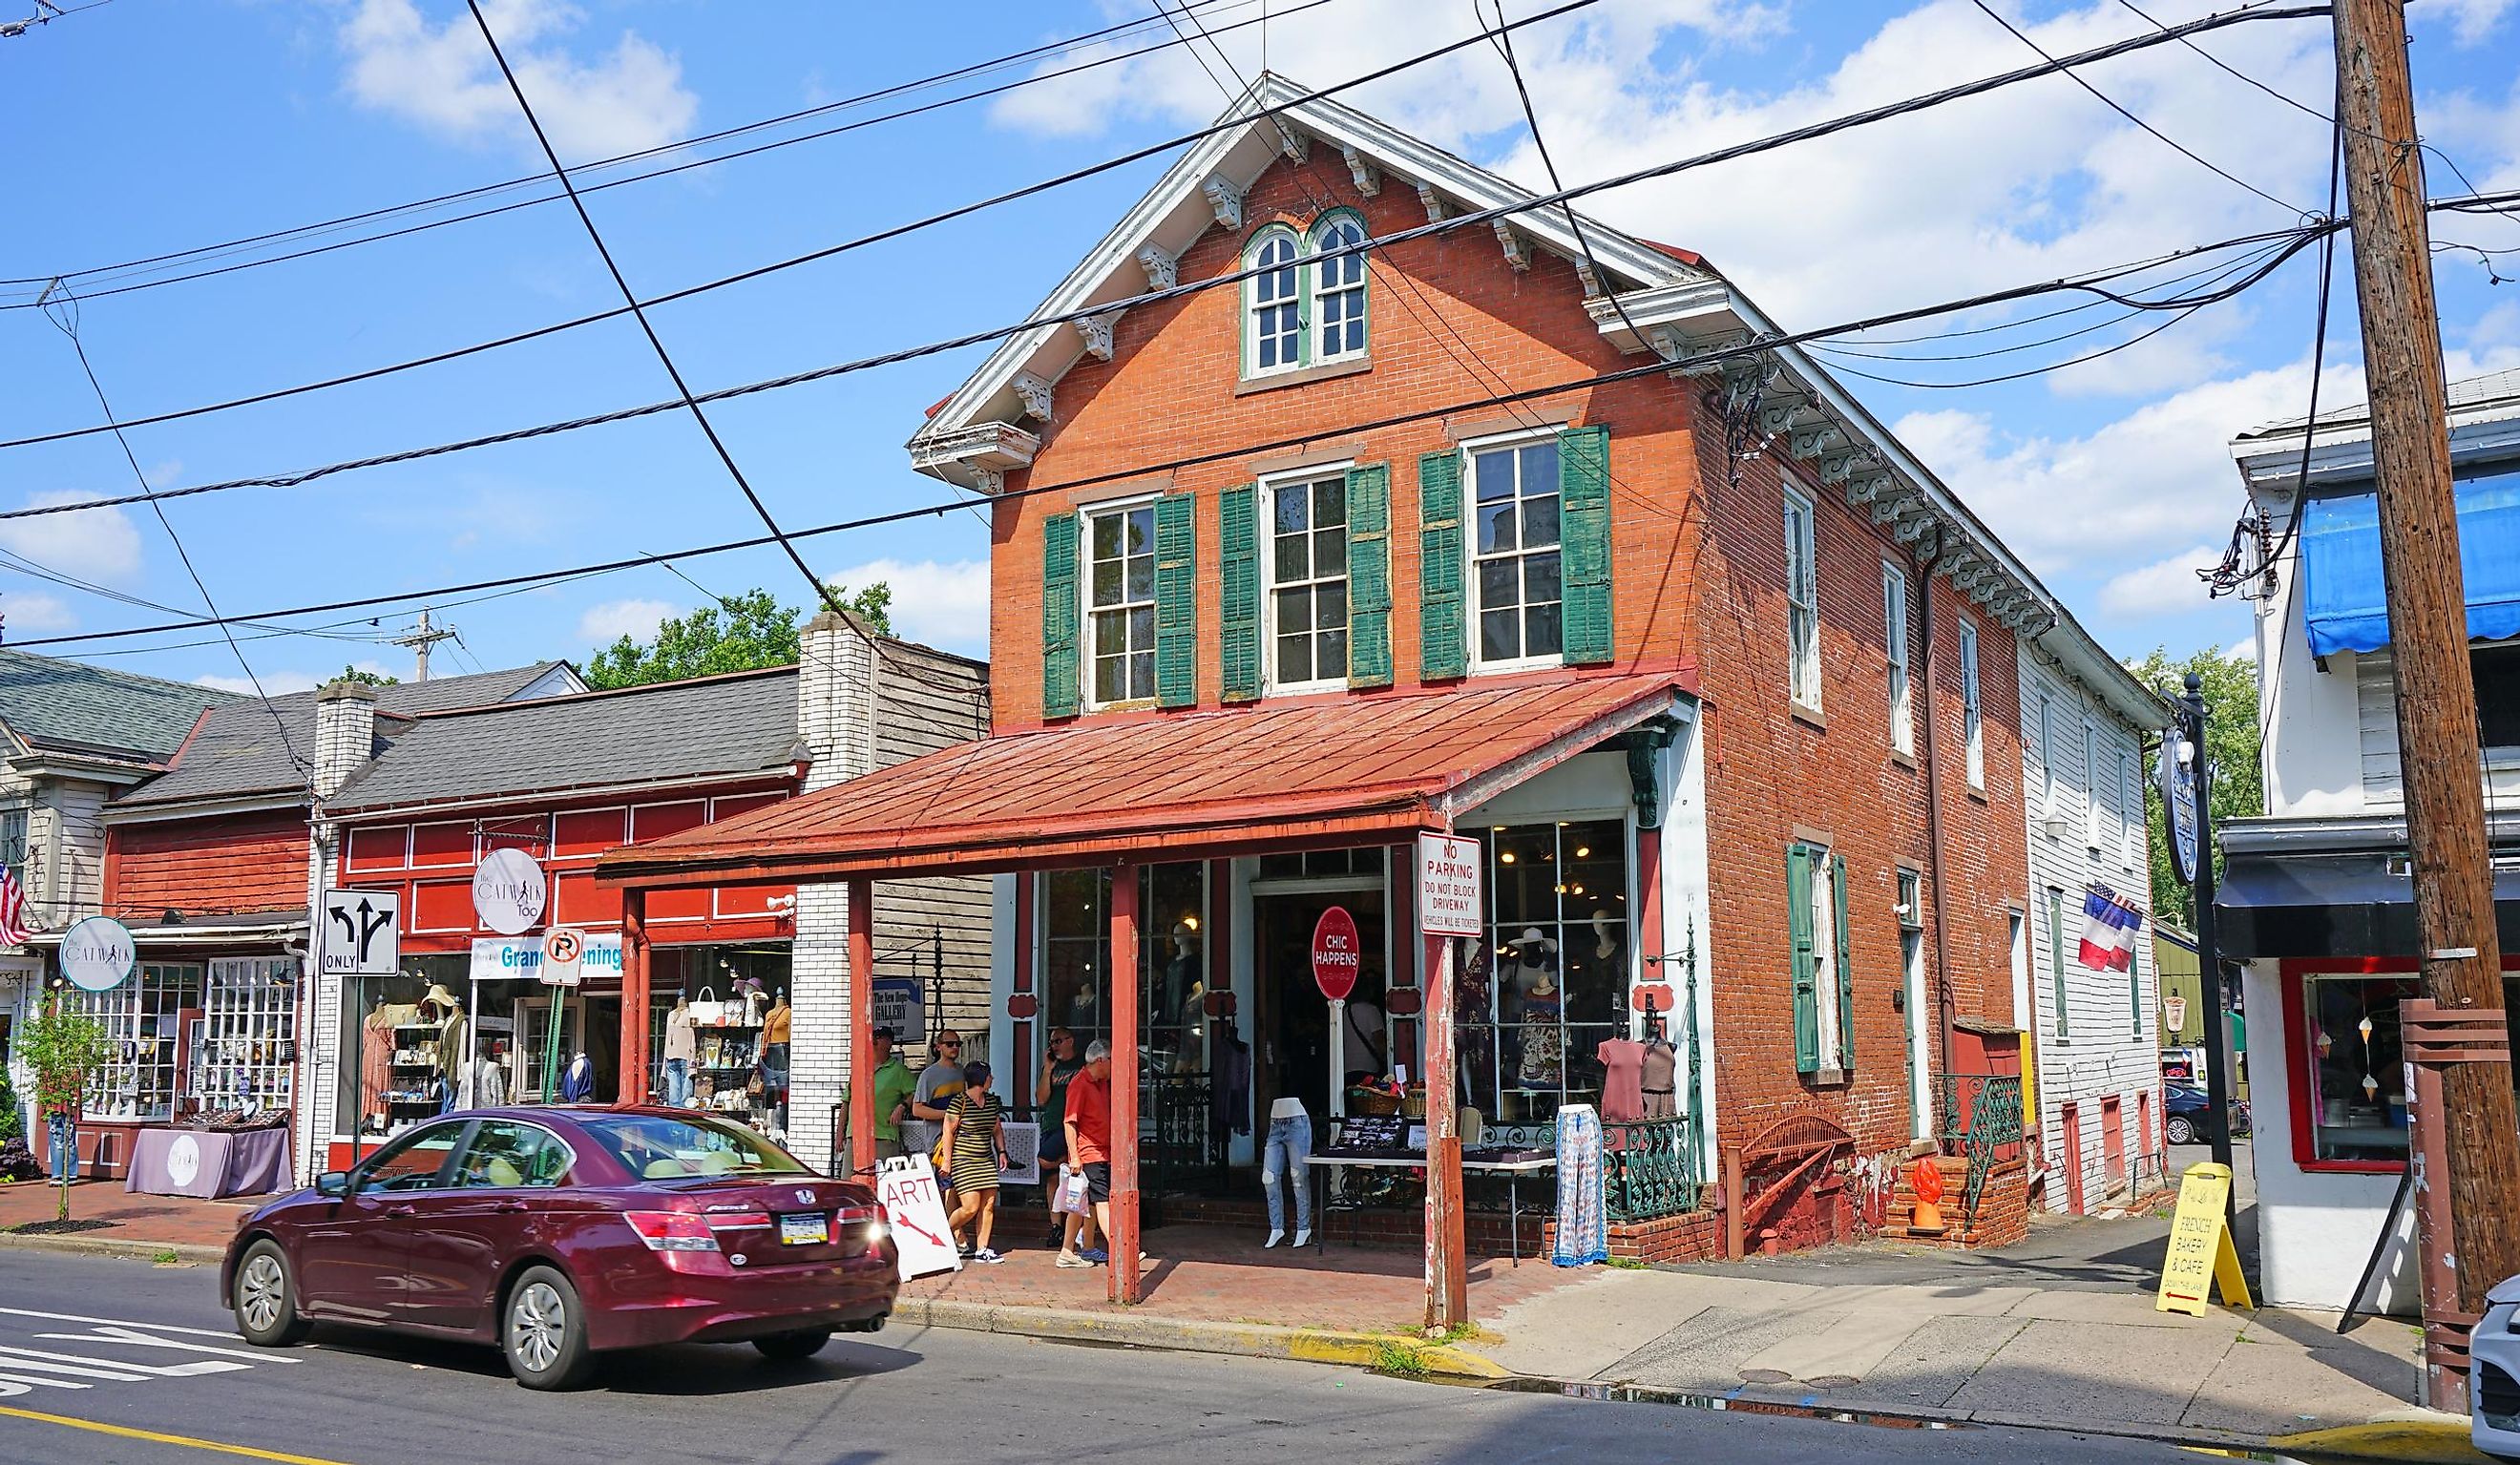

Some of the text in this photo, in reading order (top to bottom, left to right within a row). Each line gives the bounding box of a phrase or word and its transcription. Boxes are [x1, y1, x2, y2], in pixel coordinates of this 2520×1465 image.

[1443, 844, 1458, 860] NO
[1427, 860, 1473, 880] PARKING
[1424, 881, 1476, 898] DO NOT BLOCK
[1433, 897, 1469, 911] DRIVEWAY
[1424, 914, 1479, 929] VEHICLES WILL BE TICKETED
[1326, 934, 1348, 950] CHIC
[326, 954, 356, 968] ONLY
[501, 946, 543, 968] Gran
[1315, 951, 1357, 966] HAPPENS
[875, 1005, 906, 1020] GALLERY
[2166, 1069, 2187, 1078] OPEN
[887, 1177, 932, 1207] ART
[2179, 1216, 2213, 1234] FRENCH
[2175, 1236, 2208, 1253] BAKERY
[2172, 1257, 2204, 1275] & CAFE
